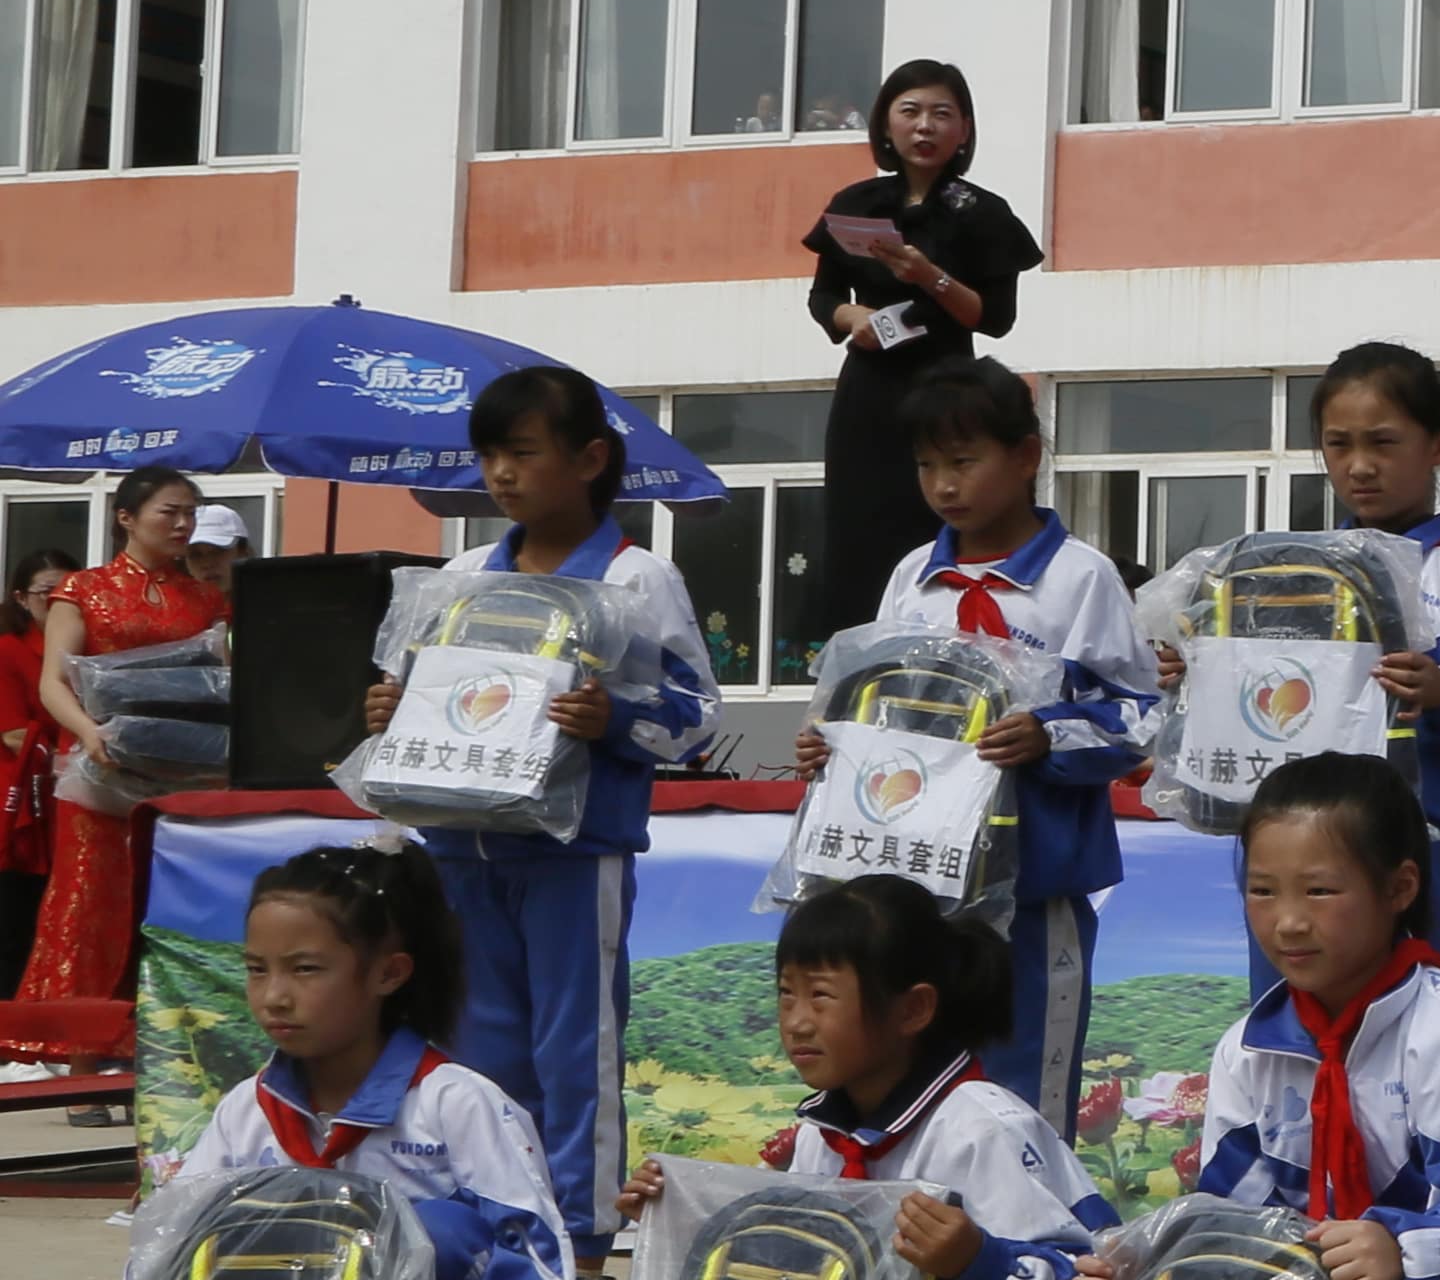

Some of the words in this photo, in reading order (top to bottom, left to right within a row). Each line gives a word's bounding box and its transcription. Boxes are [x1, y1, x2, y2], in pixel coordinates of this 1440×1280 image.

[377, 736, 553, 783] 尚赫文具套组
